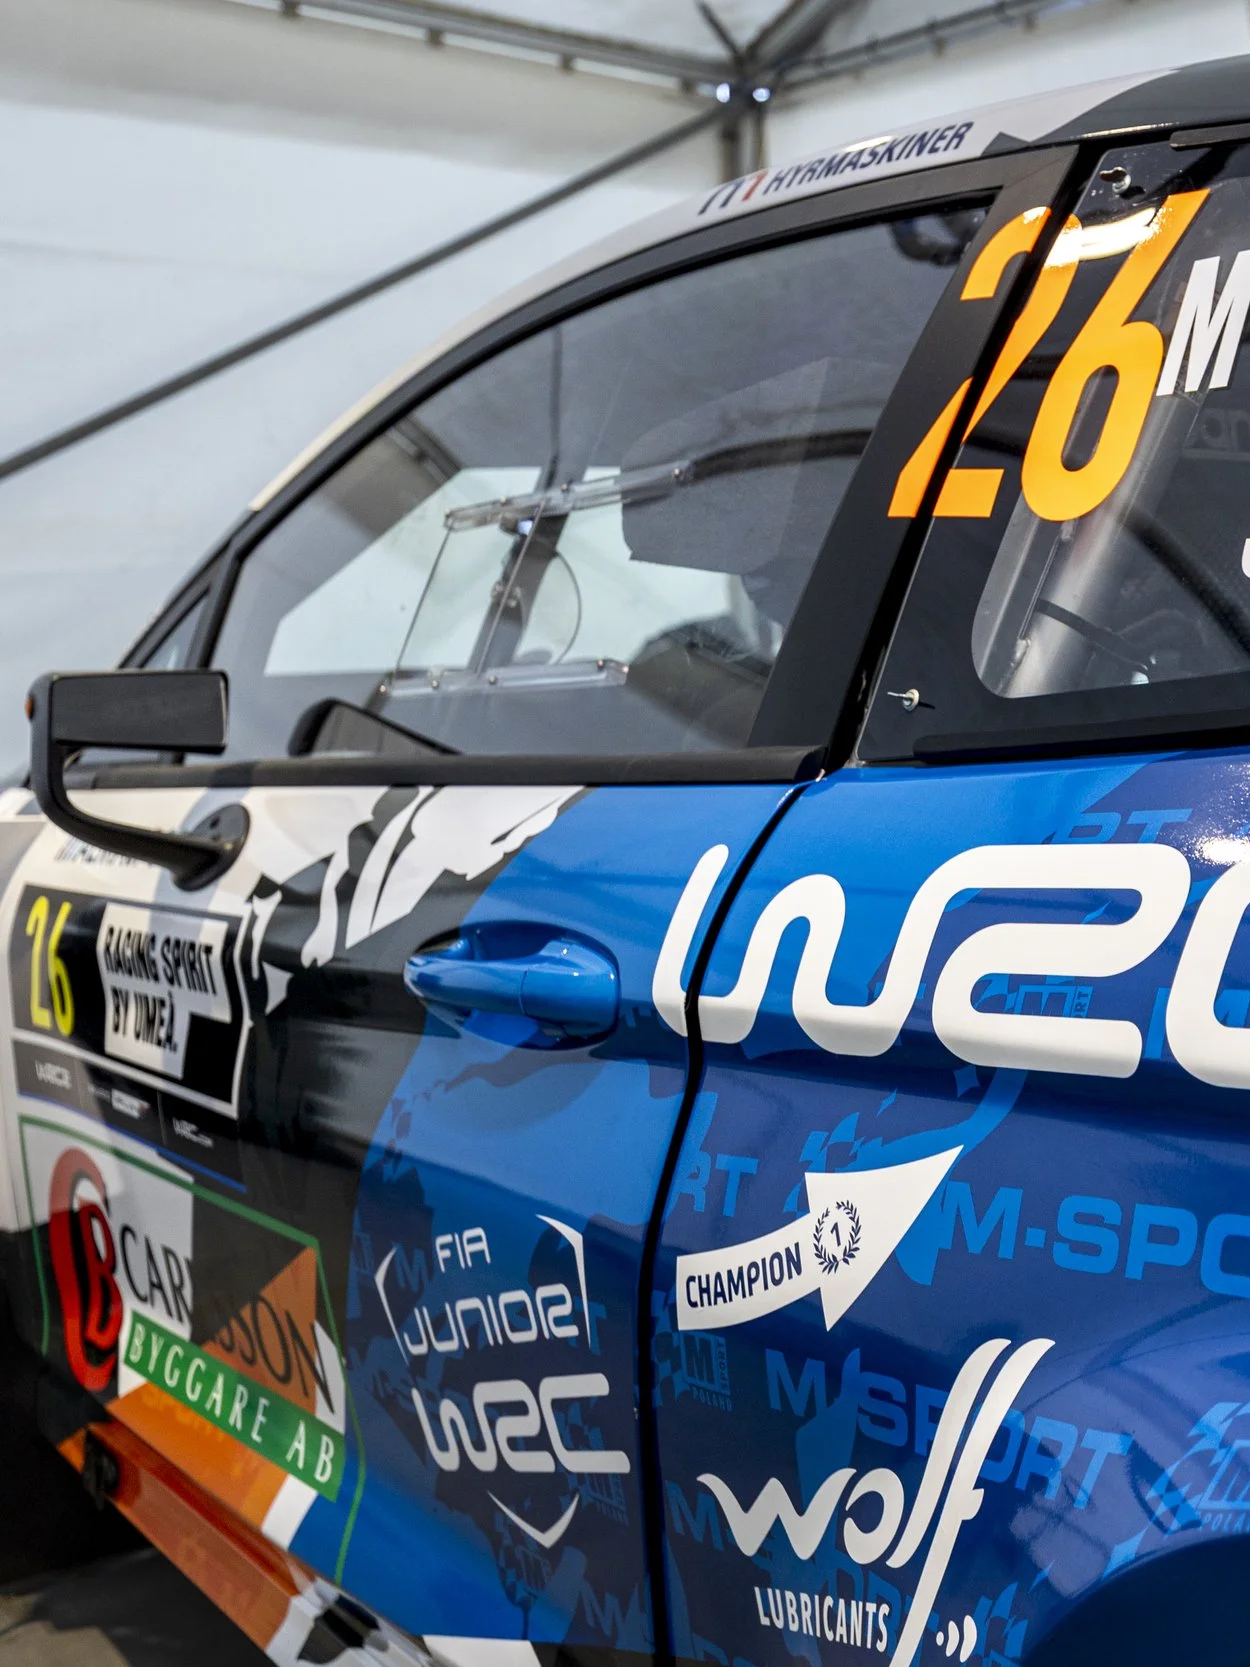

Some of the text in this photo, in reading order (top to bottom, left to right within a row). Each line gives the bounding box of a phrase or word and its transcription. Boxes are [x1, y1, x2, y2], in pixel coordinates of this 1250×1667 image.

[762, 121, 974, 196] HYRMASKINER
[887, 186, 1211, 522] 26
[25, 895, 76, 1038] 26
[103, 926, 217, 997] RACING SPIRIT
[111, 986, 129, 1037] BY
[436, 1226, 492, 1274] FIA
[685, 1241, 803, 1309] CHAMPION
[403, 1282, 580, 1356] JUNIOR
[127, 1323, 336, 1485] BYGGARE AB
[411, 1372, 631, 1474] WRC
[754, 1585, 890, 1654] LUBRICANTS
